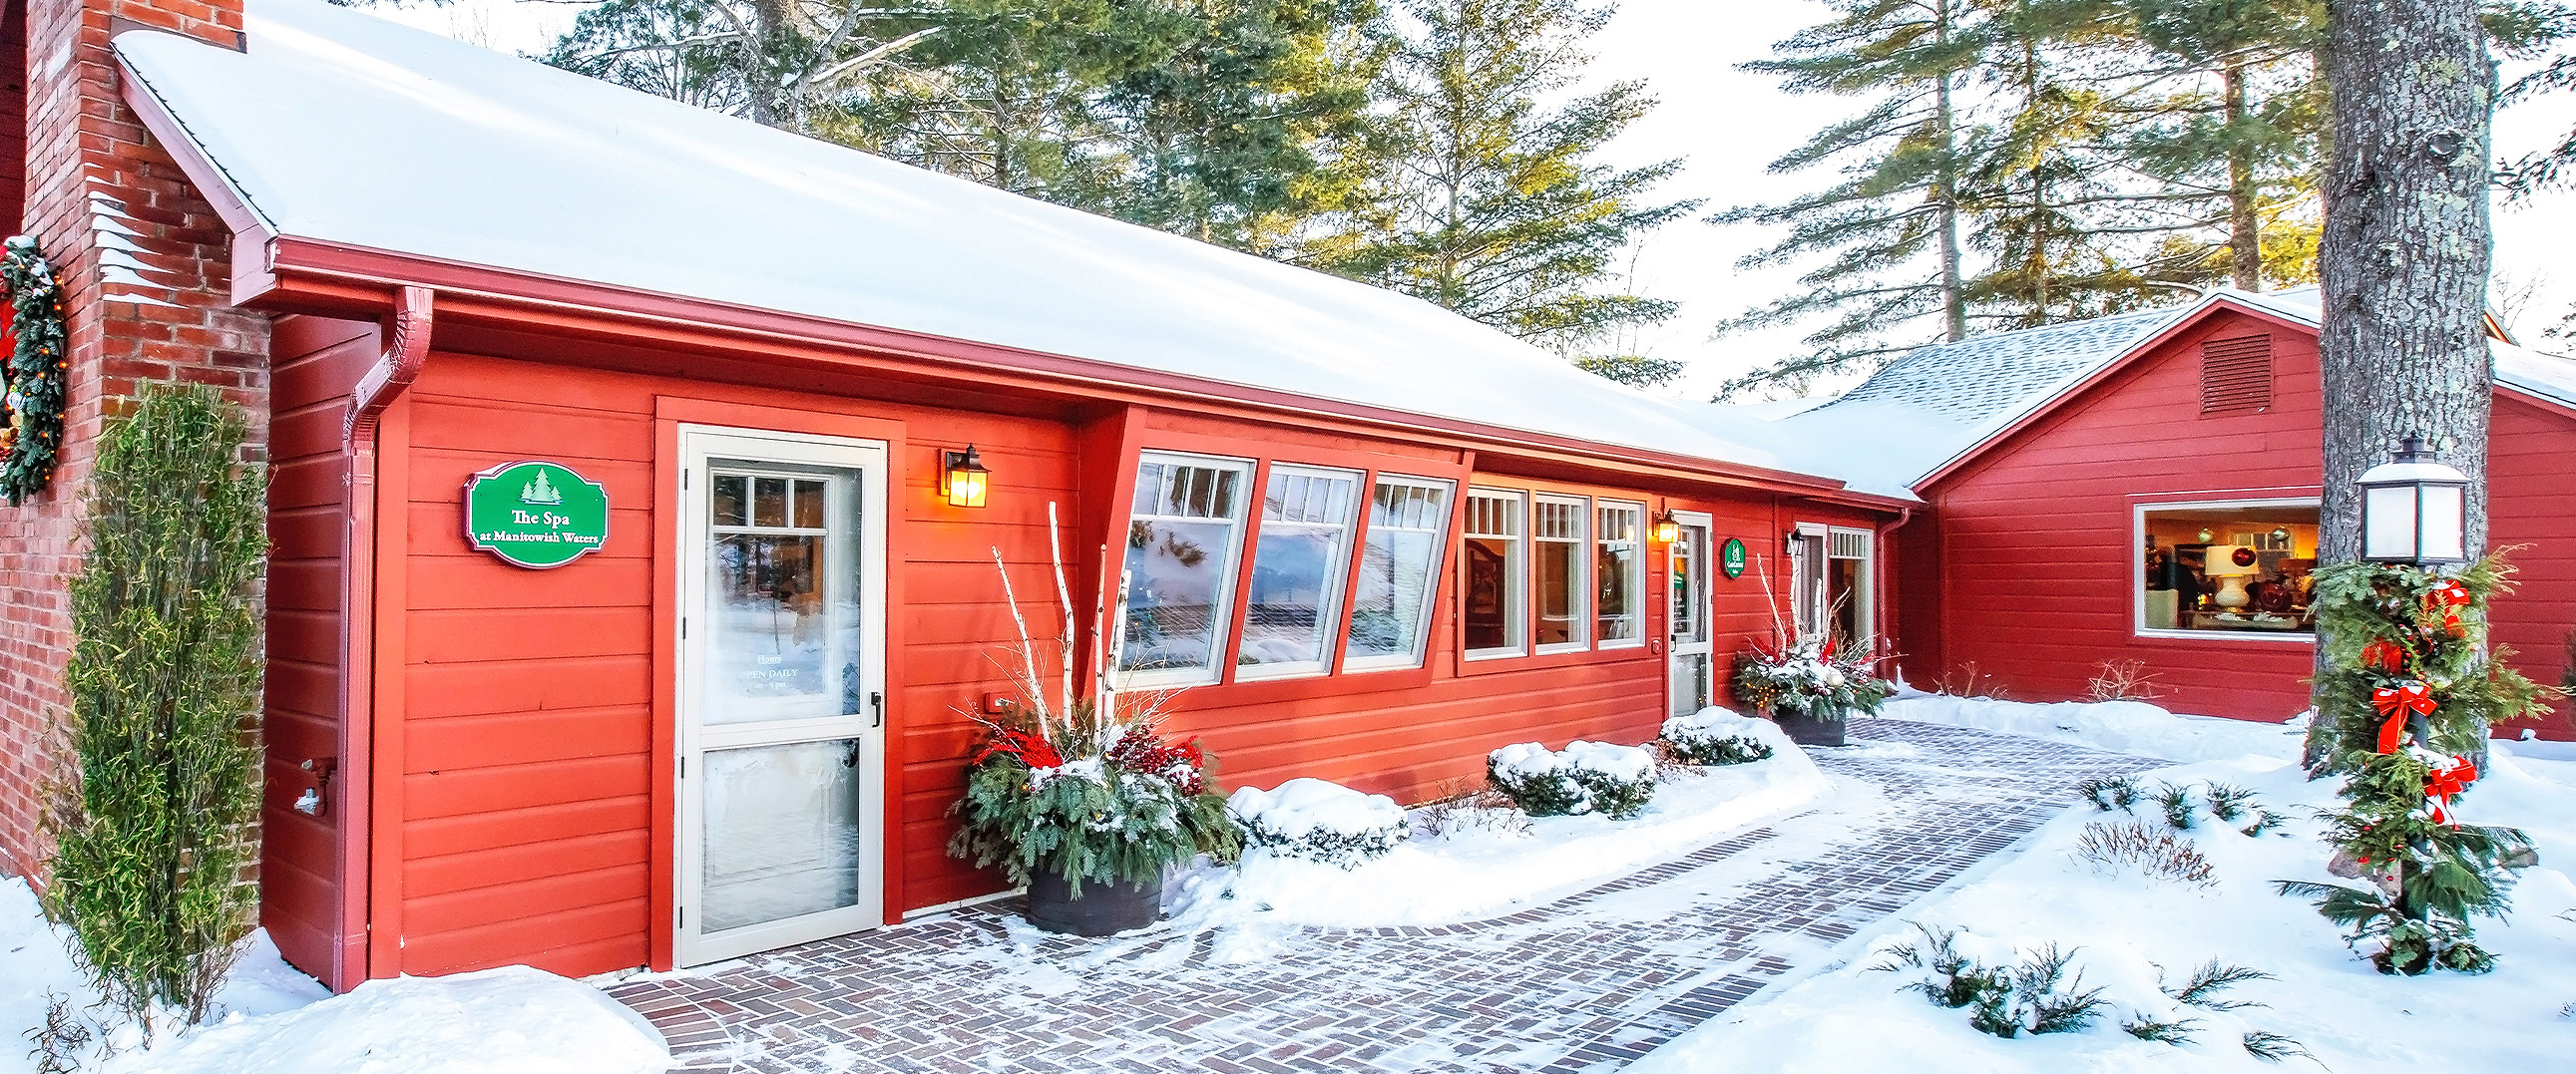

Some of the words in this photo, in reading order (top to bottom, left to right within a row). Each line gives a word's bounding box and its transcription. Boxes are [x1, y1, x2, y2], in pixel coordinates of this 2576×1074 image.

[511, 510, 540, 525] The
[543, 512, 570, 529] Spa
[480, 532, 492, 541] at
[493, 531, 560, 542] Manitowish
[562, 532, 599, 543] Waters
[757, 654, 781, 664] Hours
[743, 669, 766, 679] PEN
[769, 668, 799, 678] DAILY
